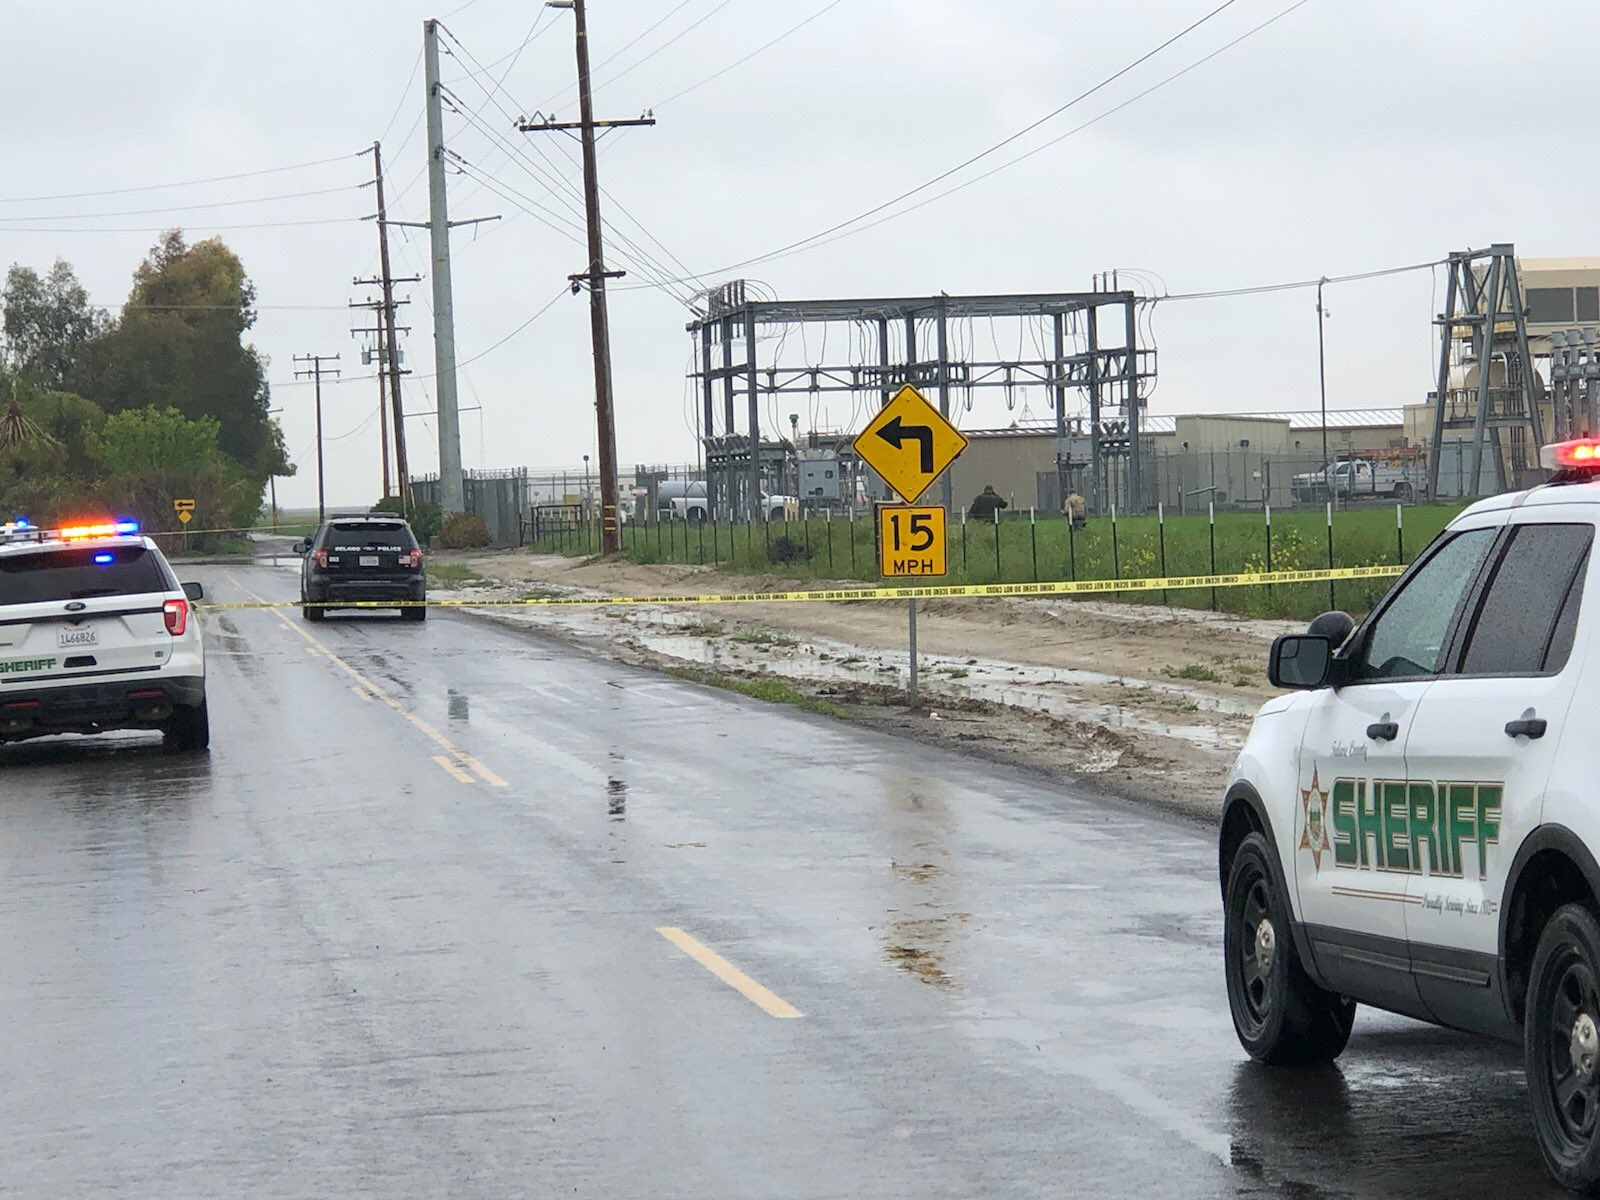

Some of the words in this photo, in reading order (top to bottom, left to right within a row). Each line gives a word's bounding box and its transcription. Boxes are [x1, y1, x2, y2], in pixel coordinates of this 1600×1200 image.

[891, 514, 934, 551] 15
[894, 559, 933, 574] MPH
[61, 632, 96, 644] 1466826
[1333, 777, 1504, 881] SHERIFF
